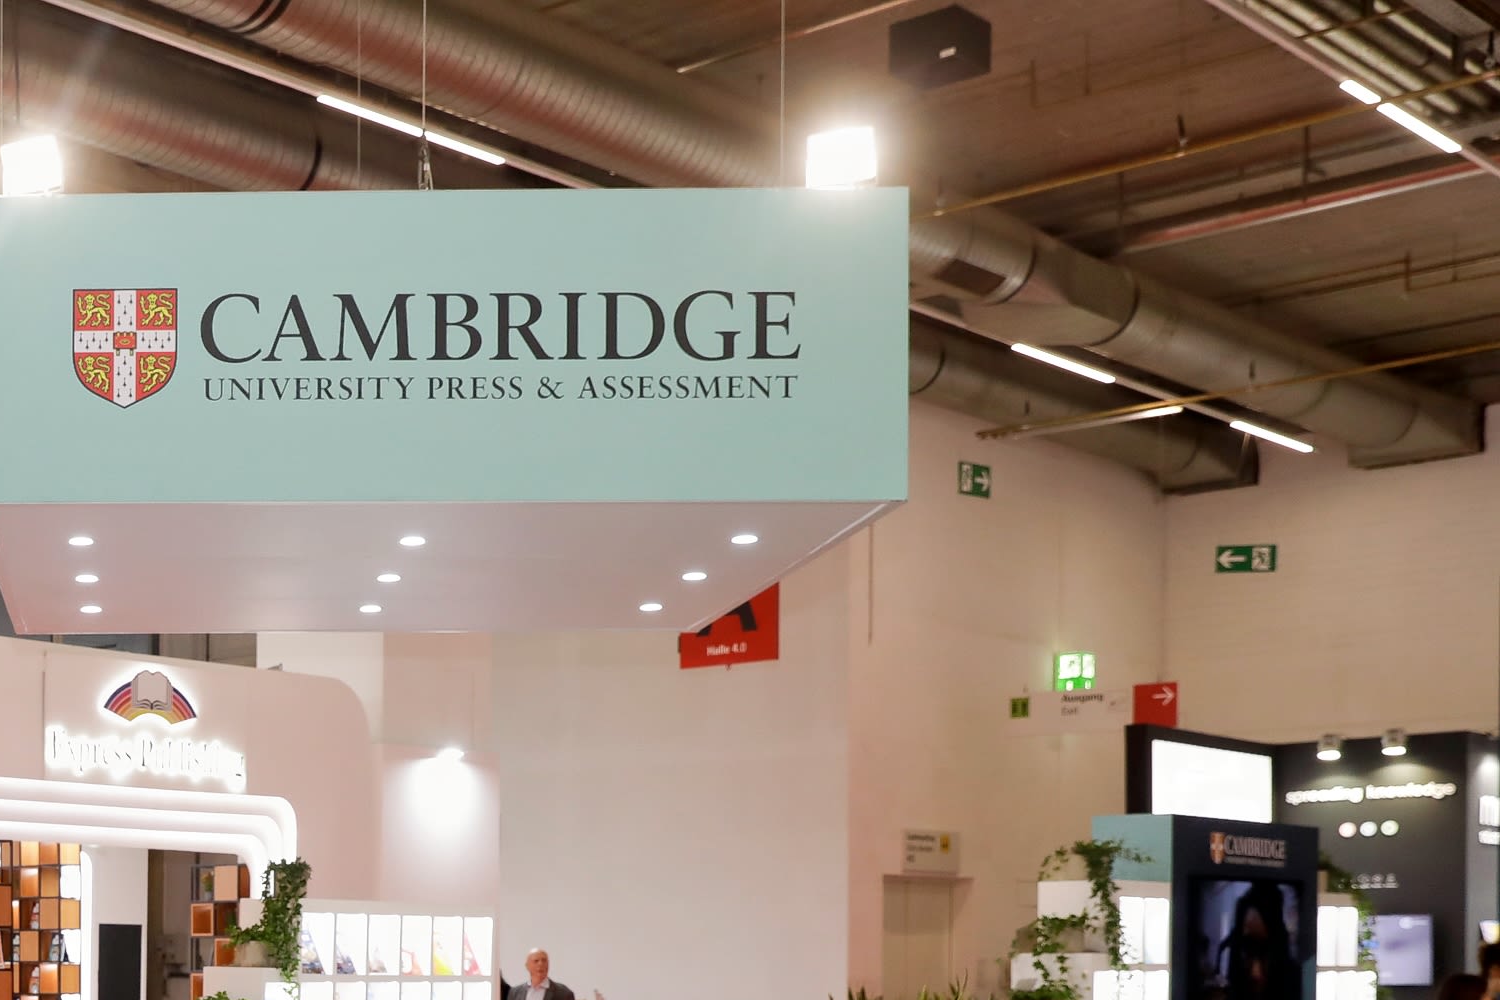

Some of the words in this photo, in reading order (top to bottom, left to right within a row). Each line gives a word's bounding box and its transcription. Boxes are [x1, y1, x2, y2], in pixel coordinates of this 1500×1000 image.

[201, 289, 801, 364] CAMBRIDGE
[204, 376, 416, 402] UNIVERSITY
[426, 375, 523, 401] PRESS
[537, 375, 564, 401] &
[578, 374, 799, 400] ASSESSMENT
[1224, 834, 1285, 860] CAMBRIDGE
